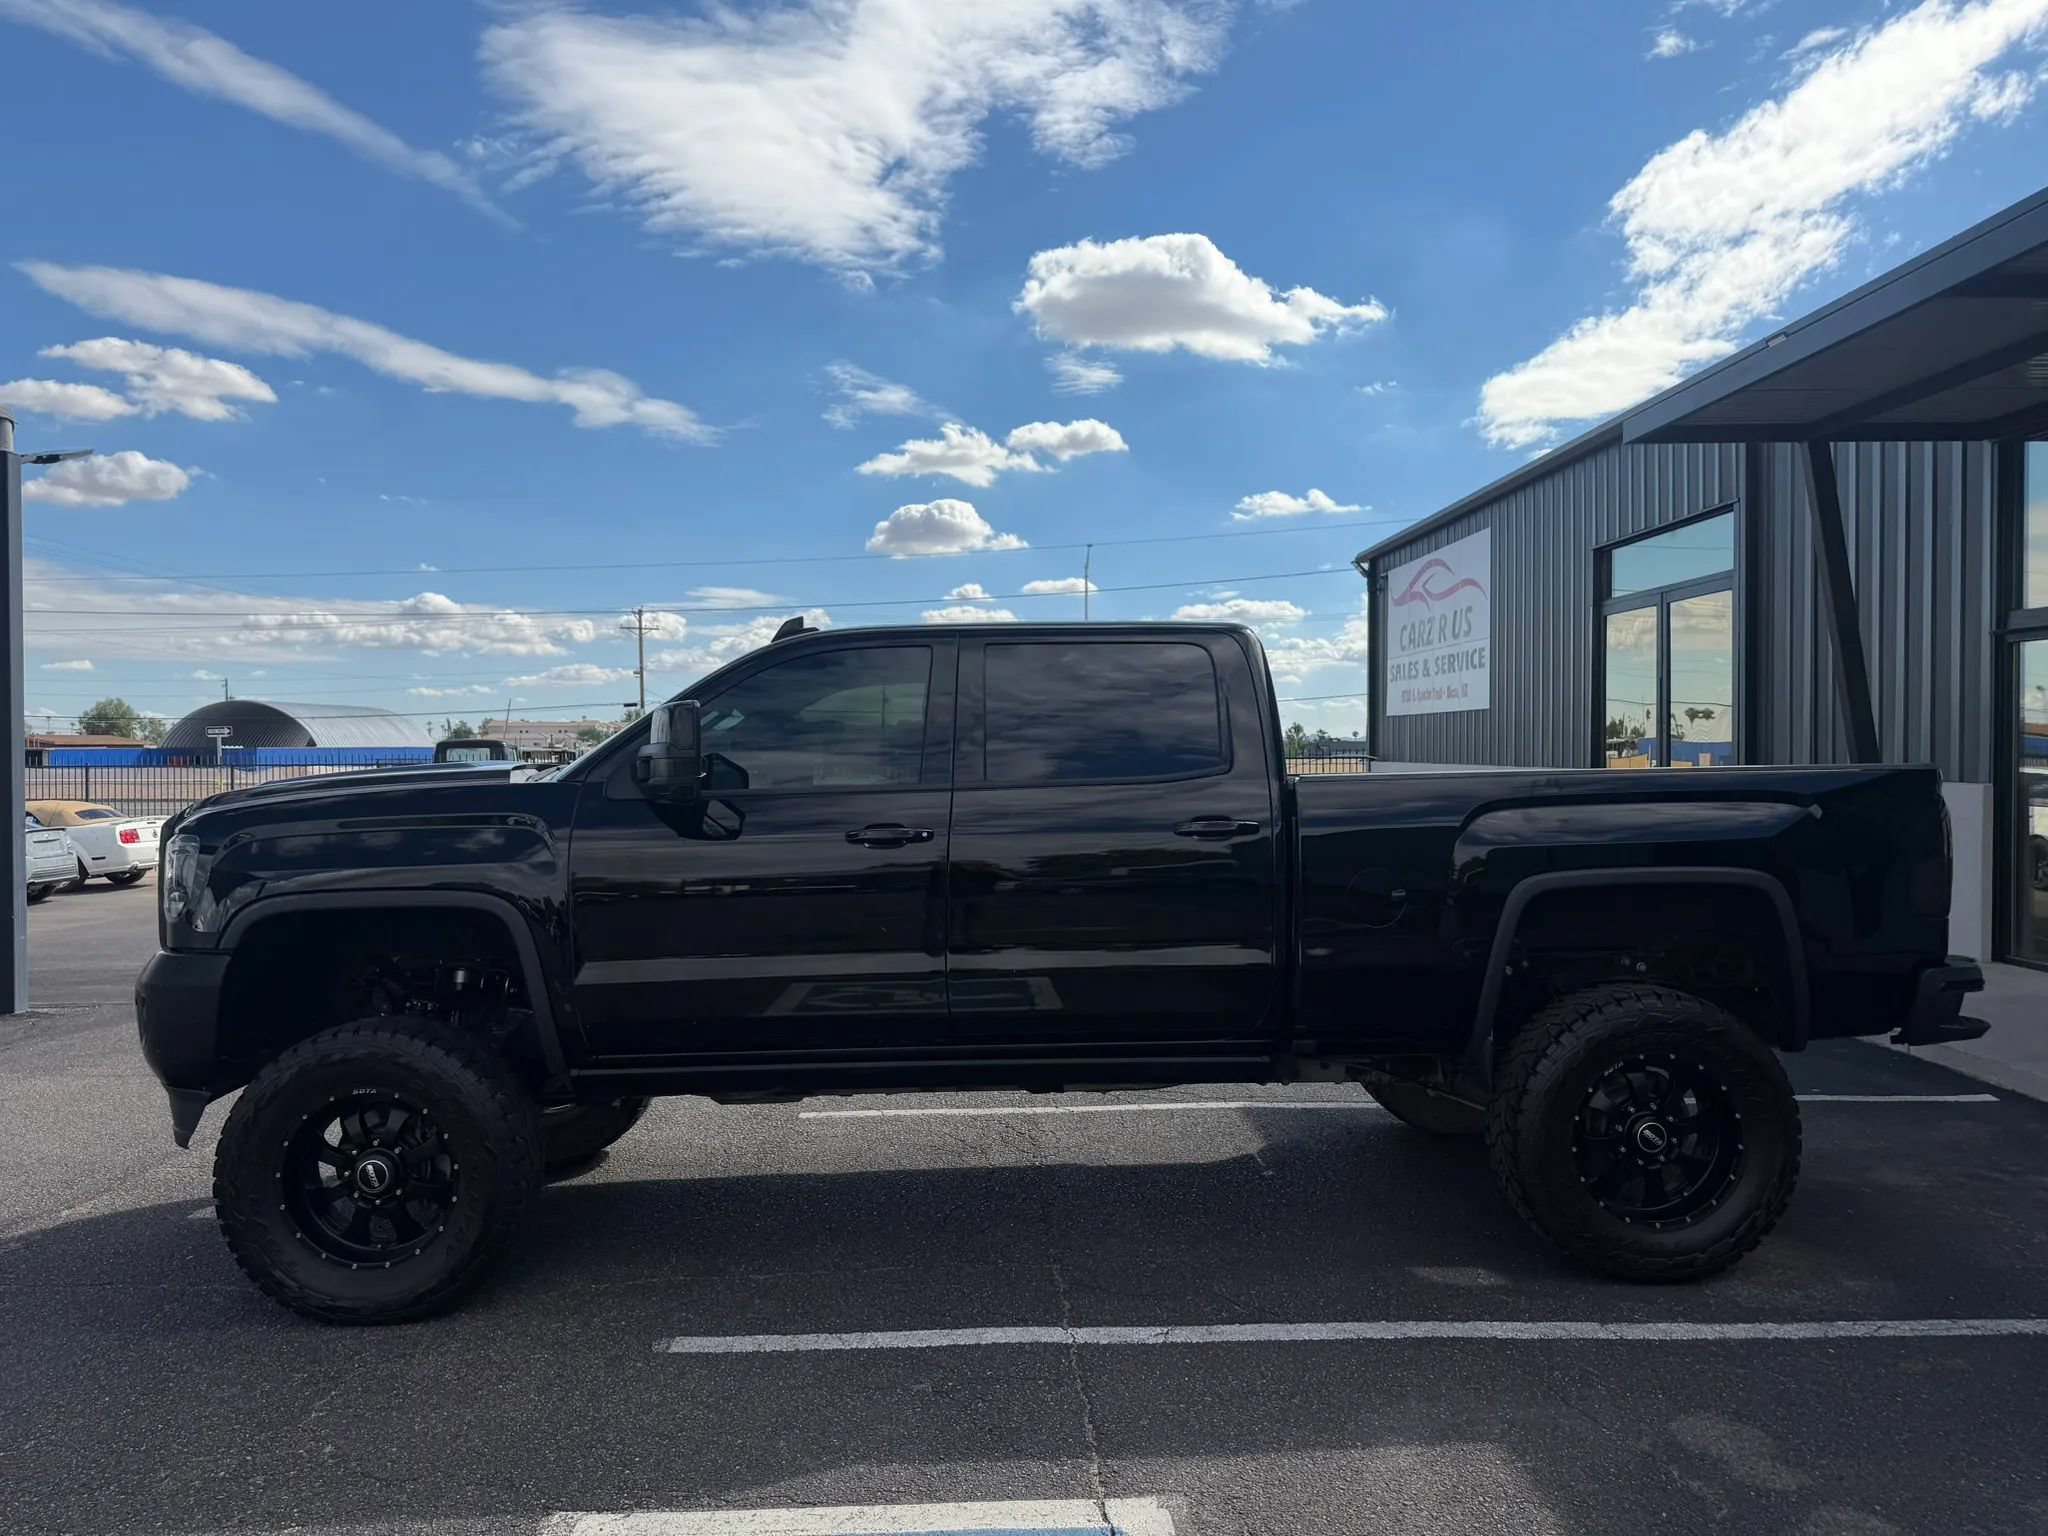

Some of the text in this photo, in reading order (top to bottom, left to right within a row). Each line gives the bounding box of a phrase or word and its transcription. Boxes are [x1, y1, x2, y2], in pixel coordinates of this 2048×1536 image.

[1439, 613, 1447, 643] R
[1452, 605, 1473, 640] US
[1390, 647, 1486, 682] SALES & SERVICE
